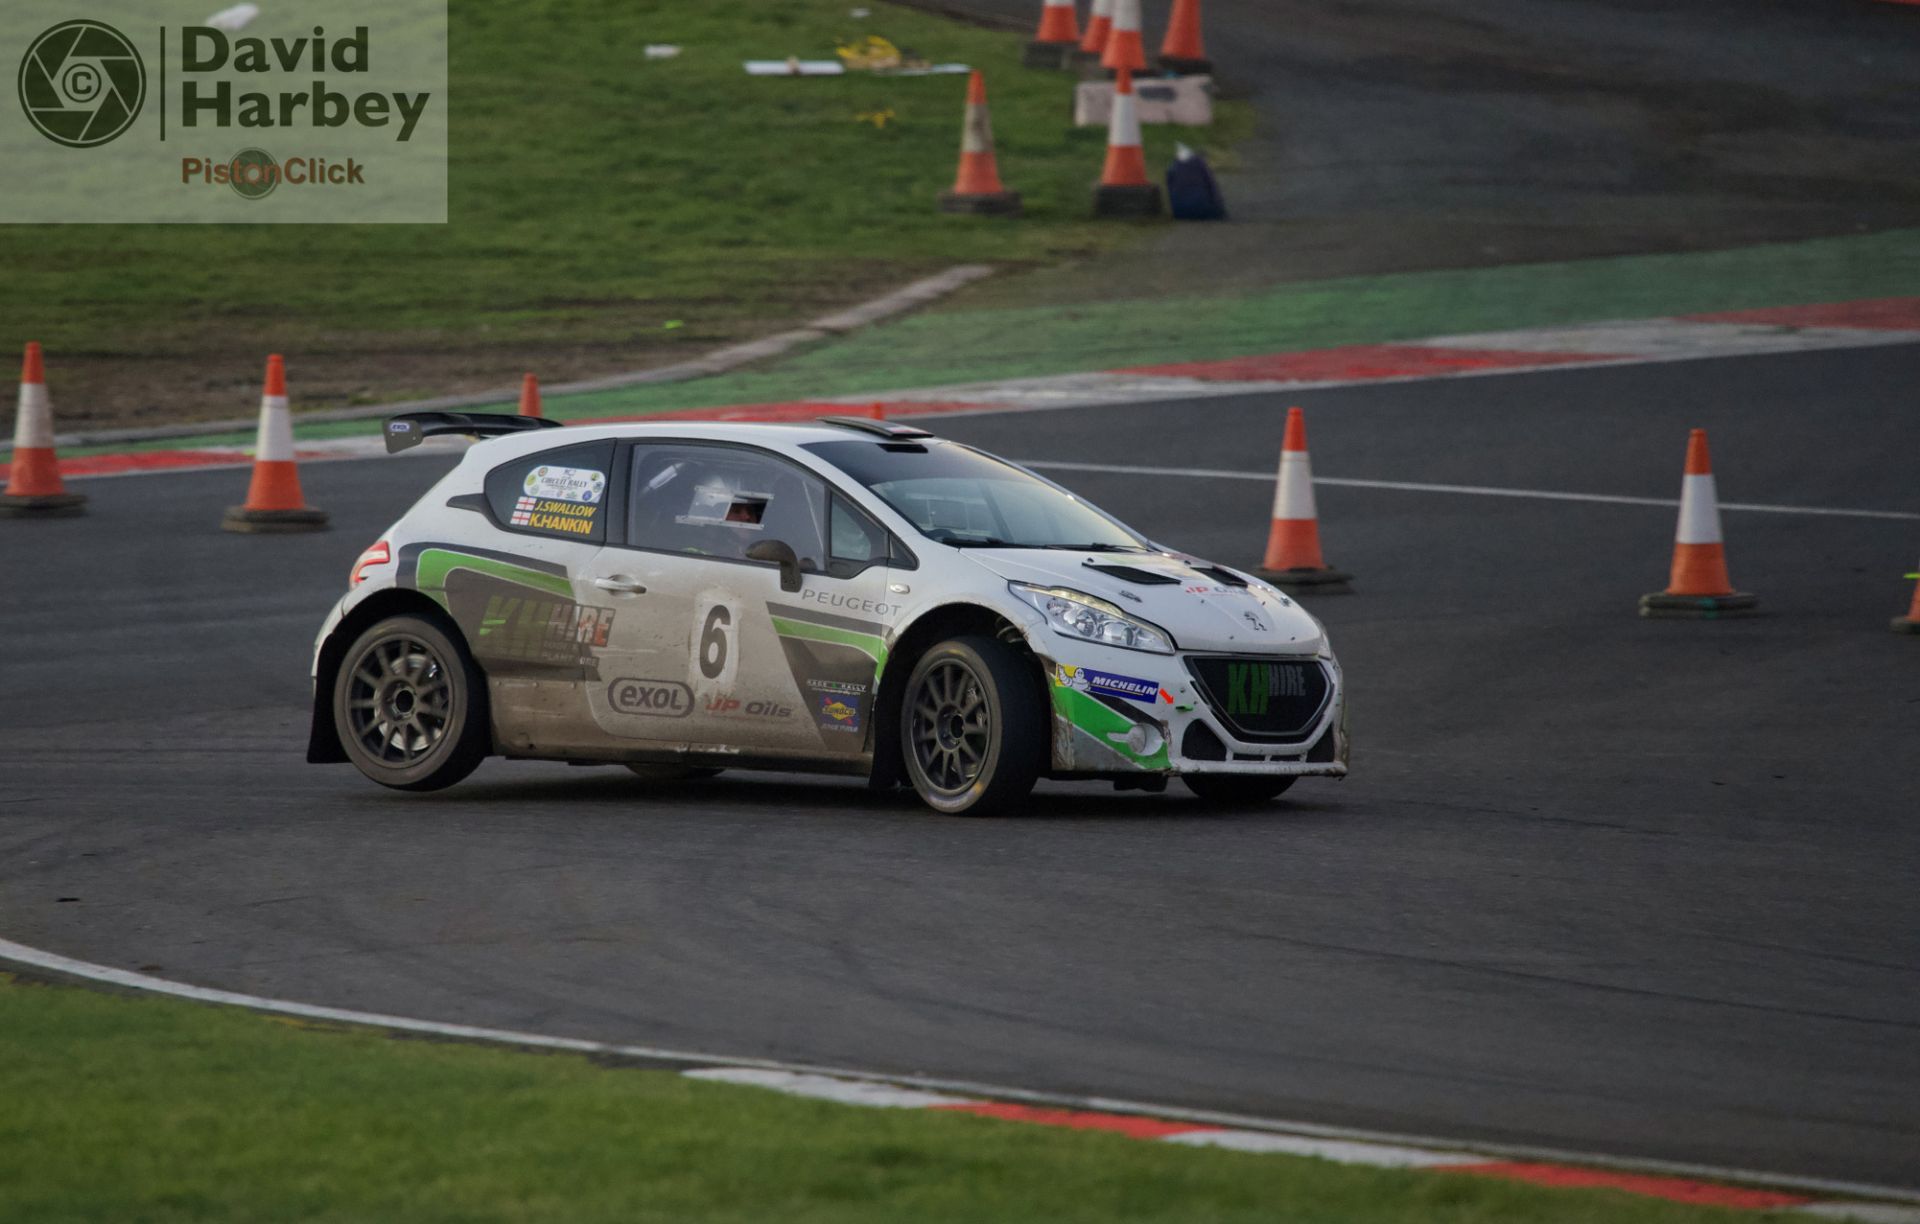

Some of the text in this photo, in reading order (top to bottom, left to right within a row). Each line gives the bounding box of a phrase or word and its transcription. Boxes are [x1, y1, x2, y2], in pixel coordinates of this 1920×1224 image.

[535, 500, 597, 517] J.SWALLOW
[529, 513, 594, 534] K.HANKIN
[802, 589, 901, 616] PEUGEOT
[700, 604, 732, 679] 6
[1093, 676, 1157, 695] MICHELIN
[705, 698, 792, 717] JP Oils
